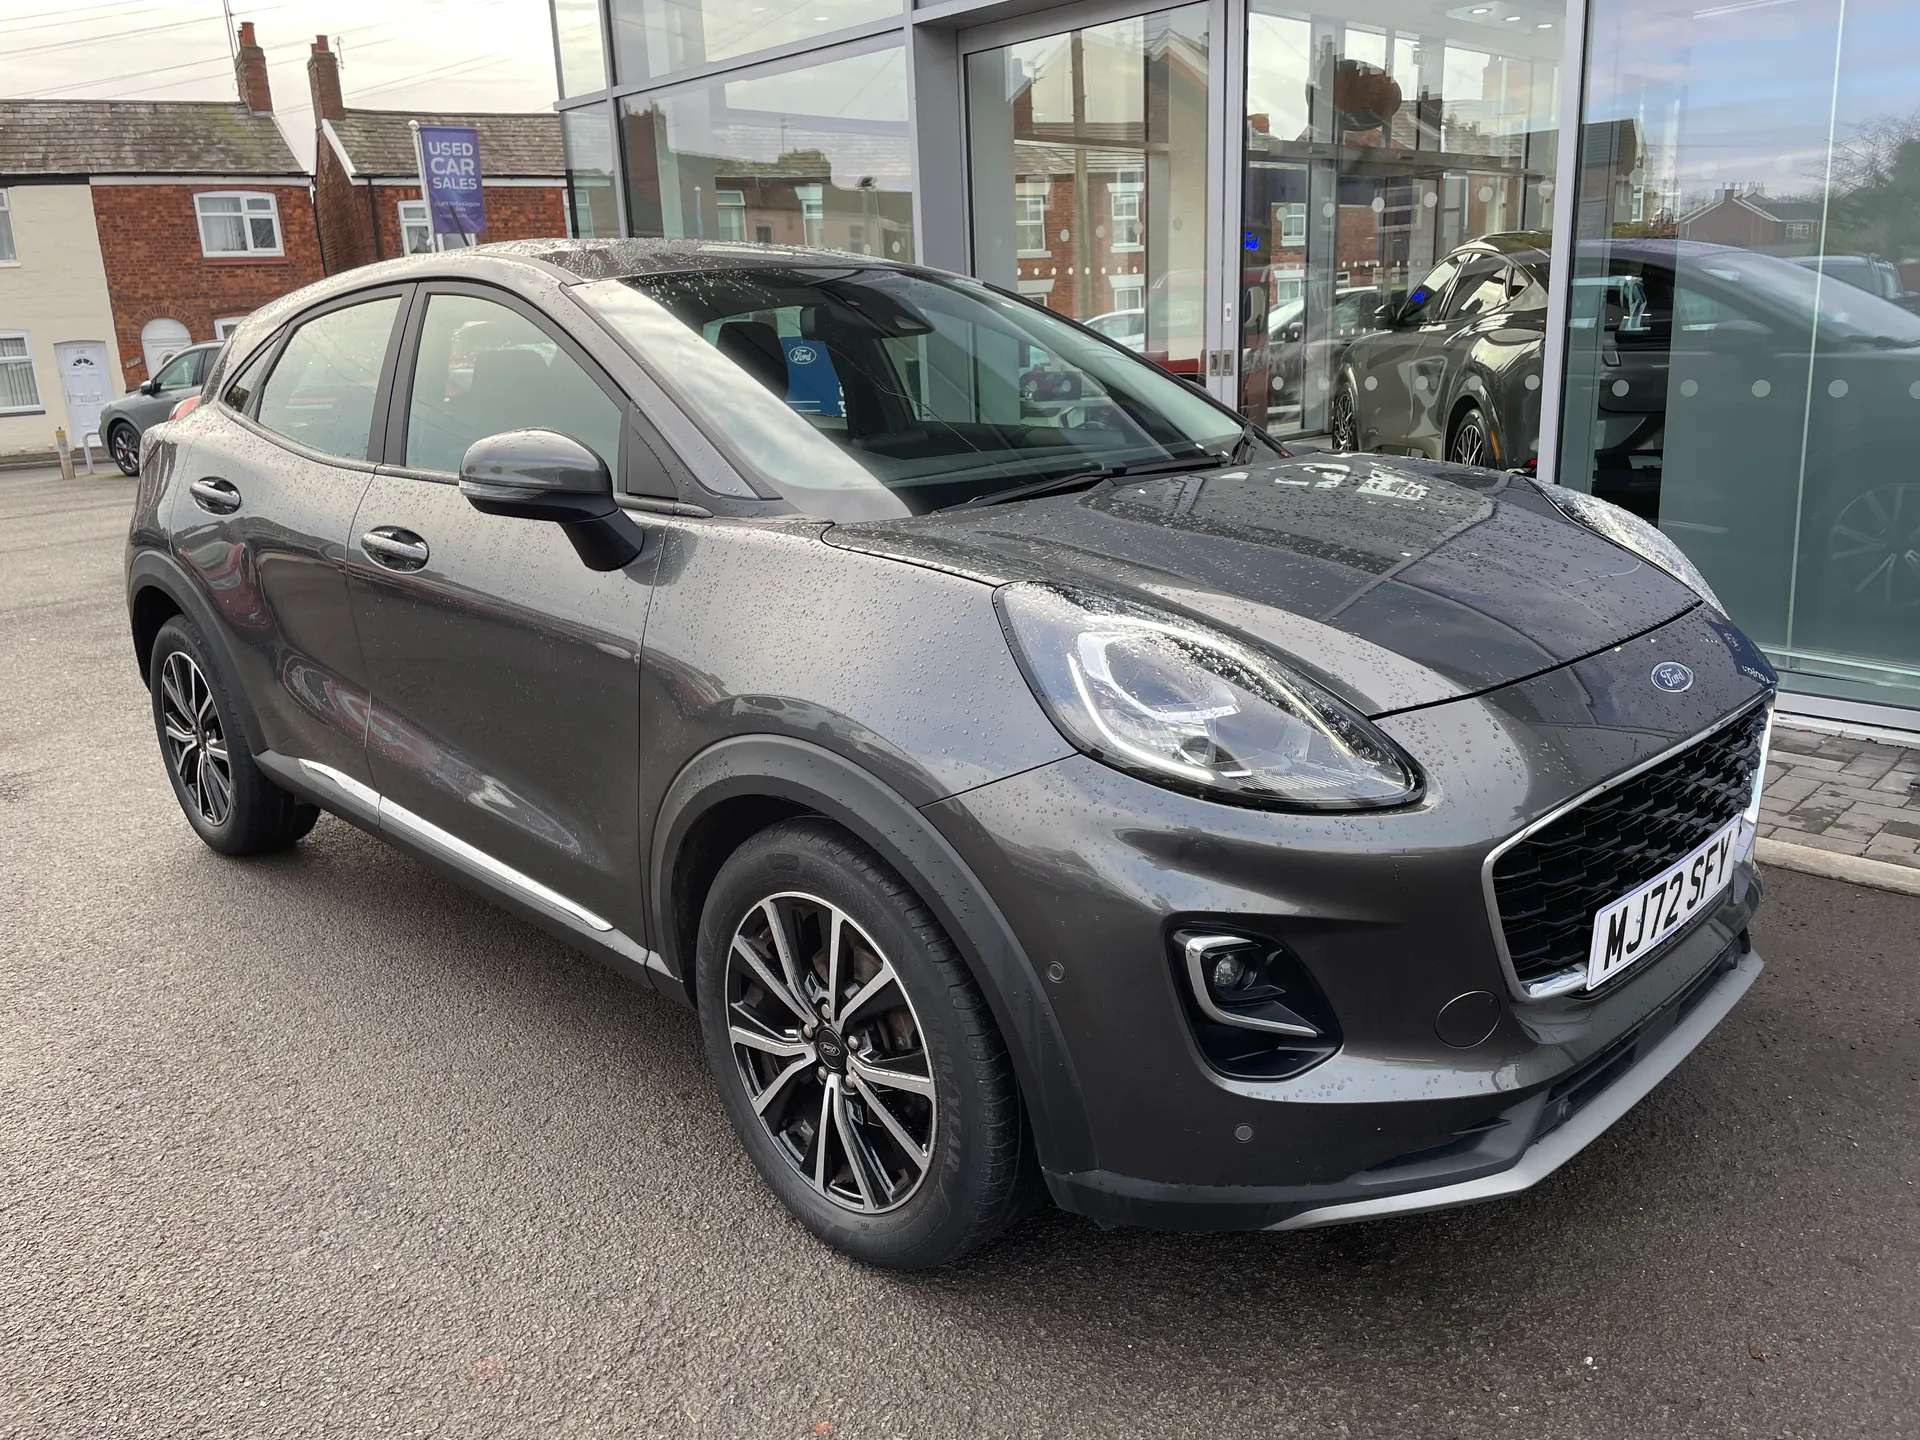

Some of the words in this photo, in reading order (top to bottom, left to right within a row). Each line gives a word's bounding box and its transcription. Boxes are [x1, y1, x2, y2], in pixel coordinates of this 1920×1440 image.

[428, 141, 474, 156] USED
[430, 157, 475, 176] CAR
[432, 176, 478, 190] SALES
[793, 348, 813, 362] Ford
[1658, 666, 1687, 688] Ford
[1603, 870, 1684, 971] MJ72
[1686, 830, 1733, 911] SFY
